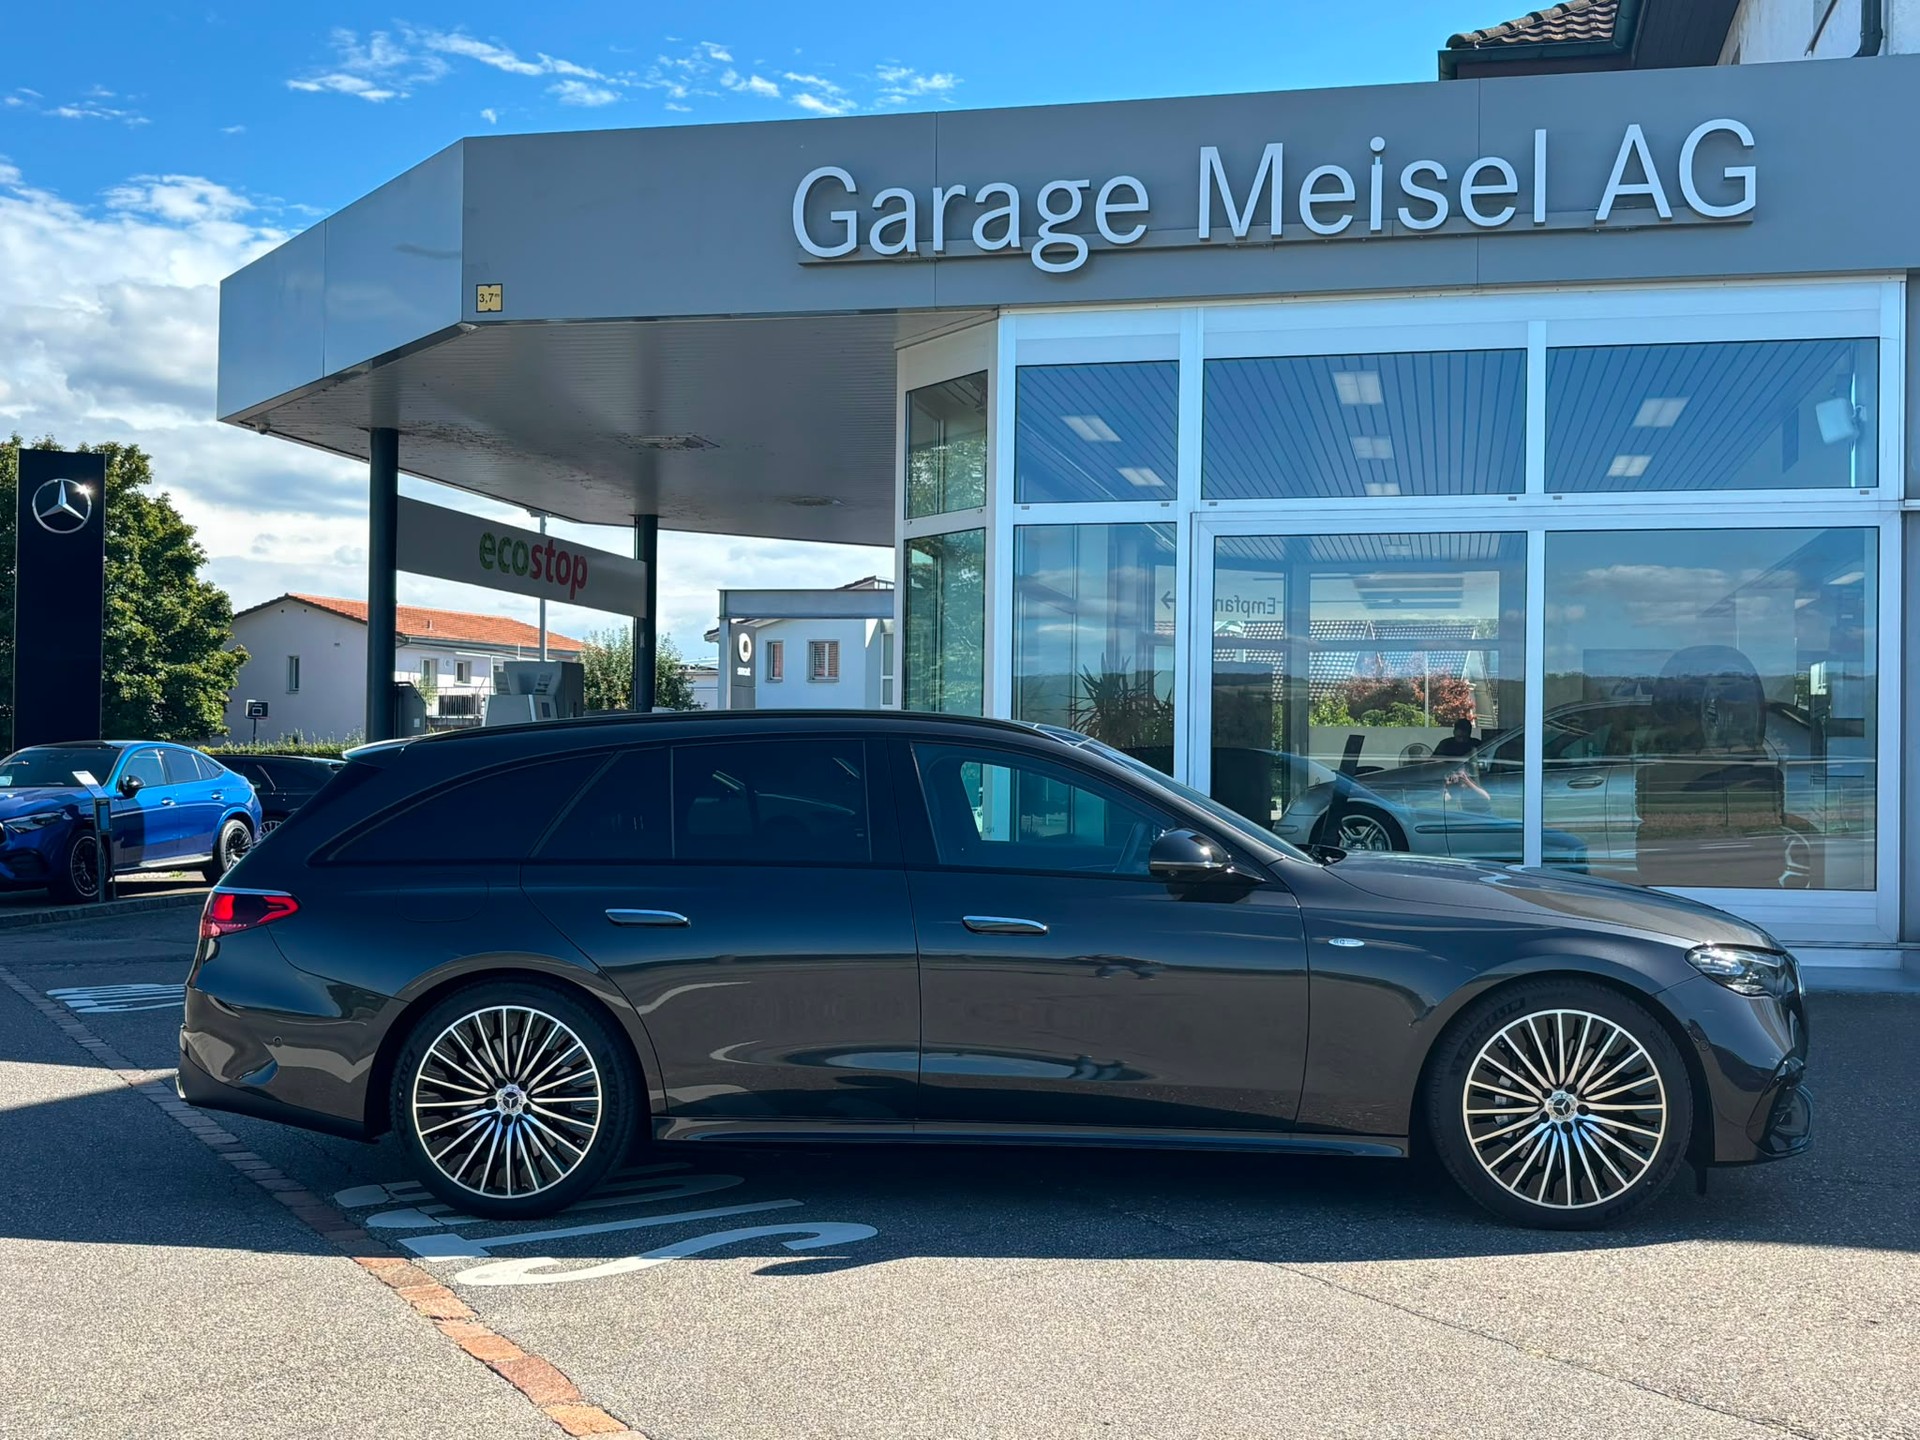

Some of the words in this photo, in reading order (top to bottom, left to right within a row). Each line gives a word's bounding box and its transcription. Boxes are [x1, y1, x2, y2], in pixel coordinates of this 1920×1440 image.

[792, 166, 1149, 273] Garage
[1198, 129, 1547, 238] Meisel
[1595, 118, 1757, 221] AG
[478, 532, 588, 600] ecostop
